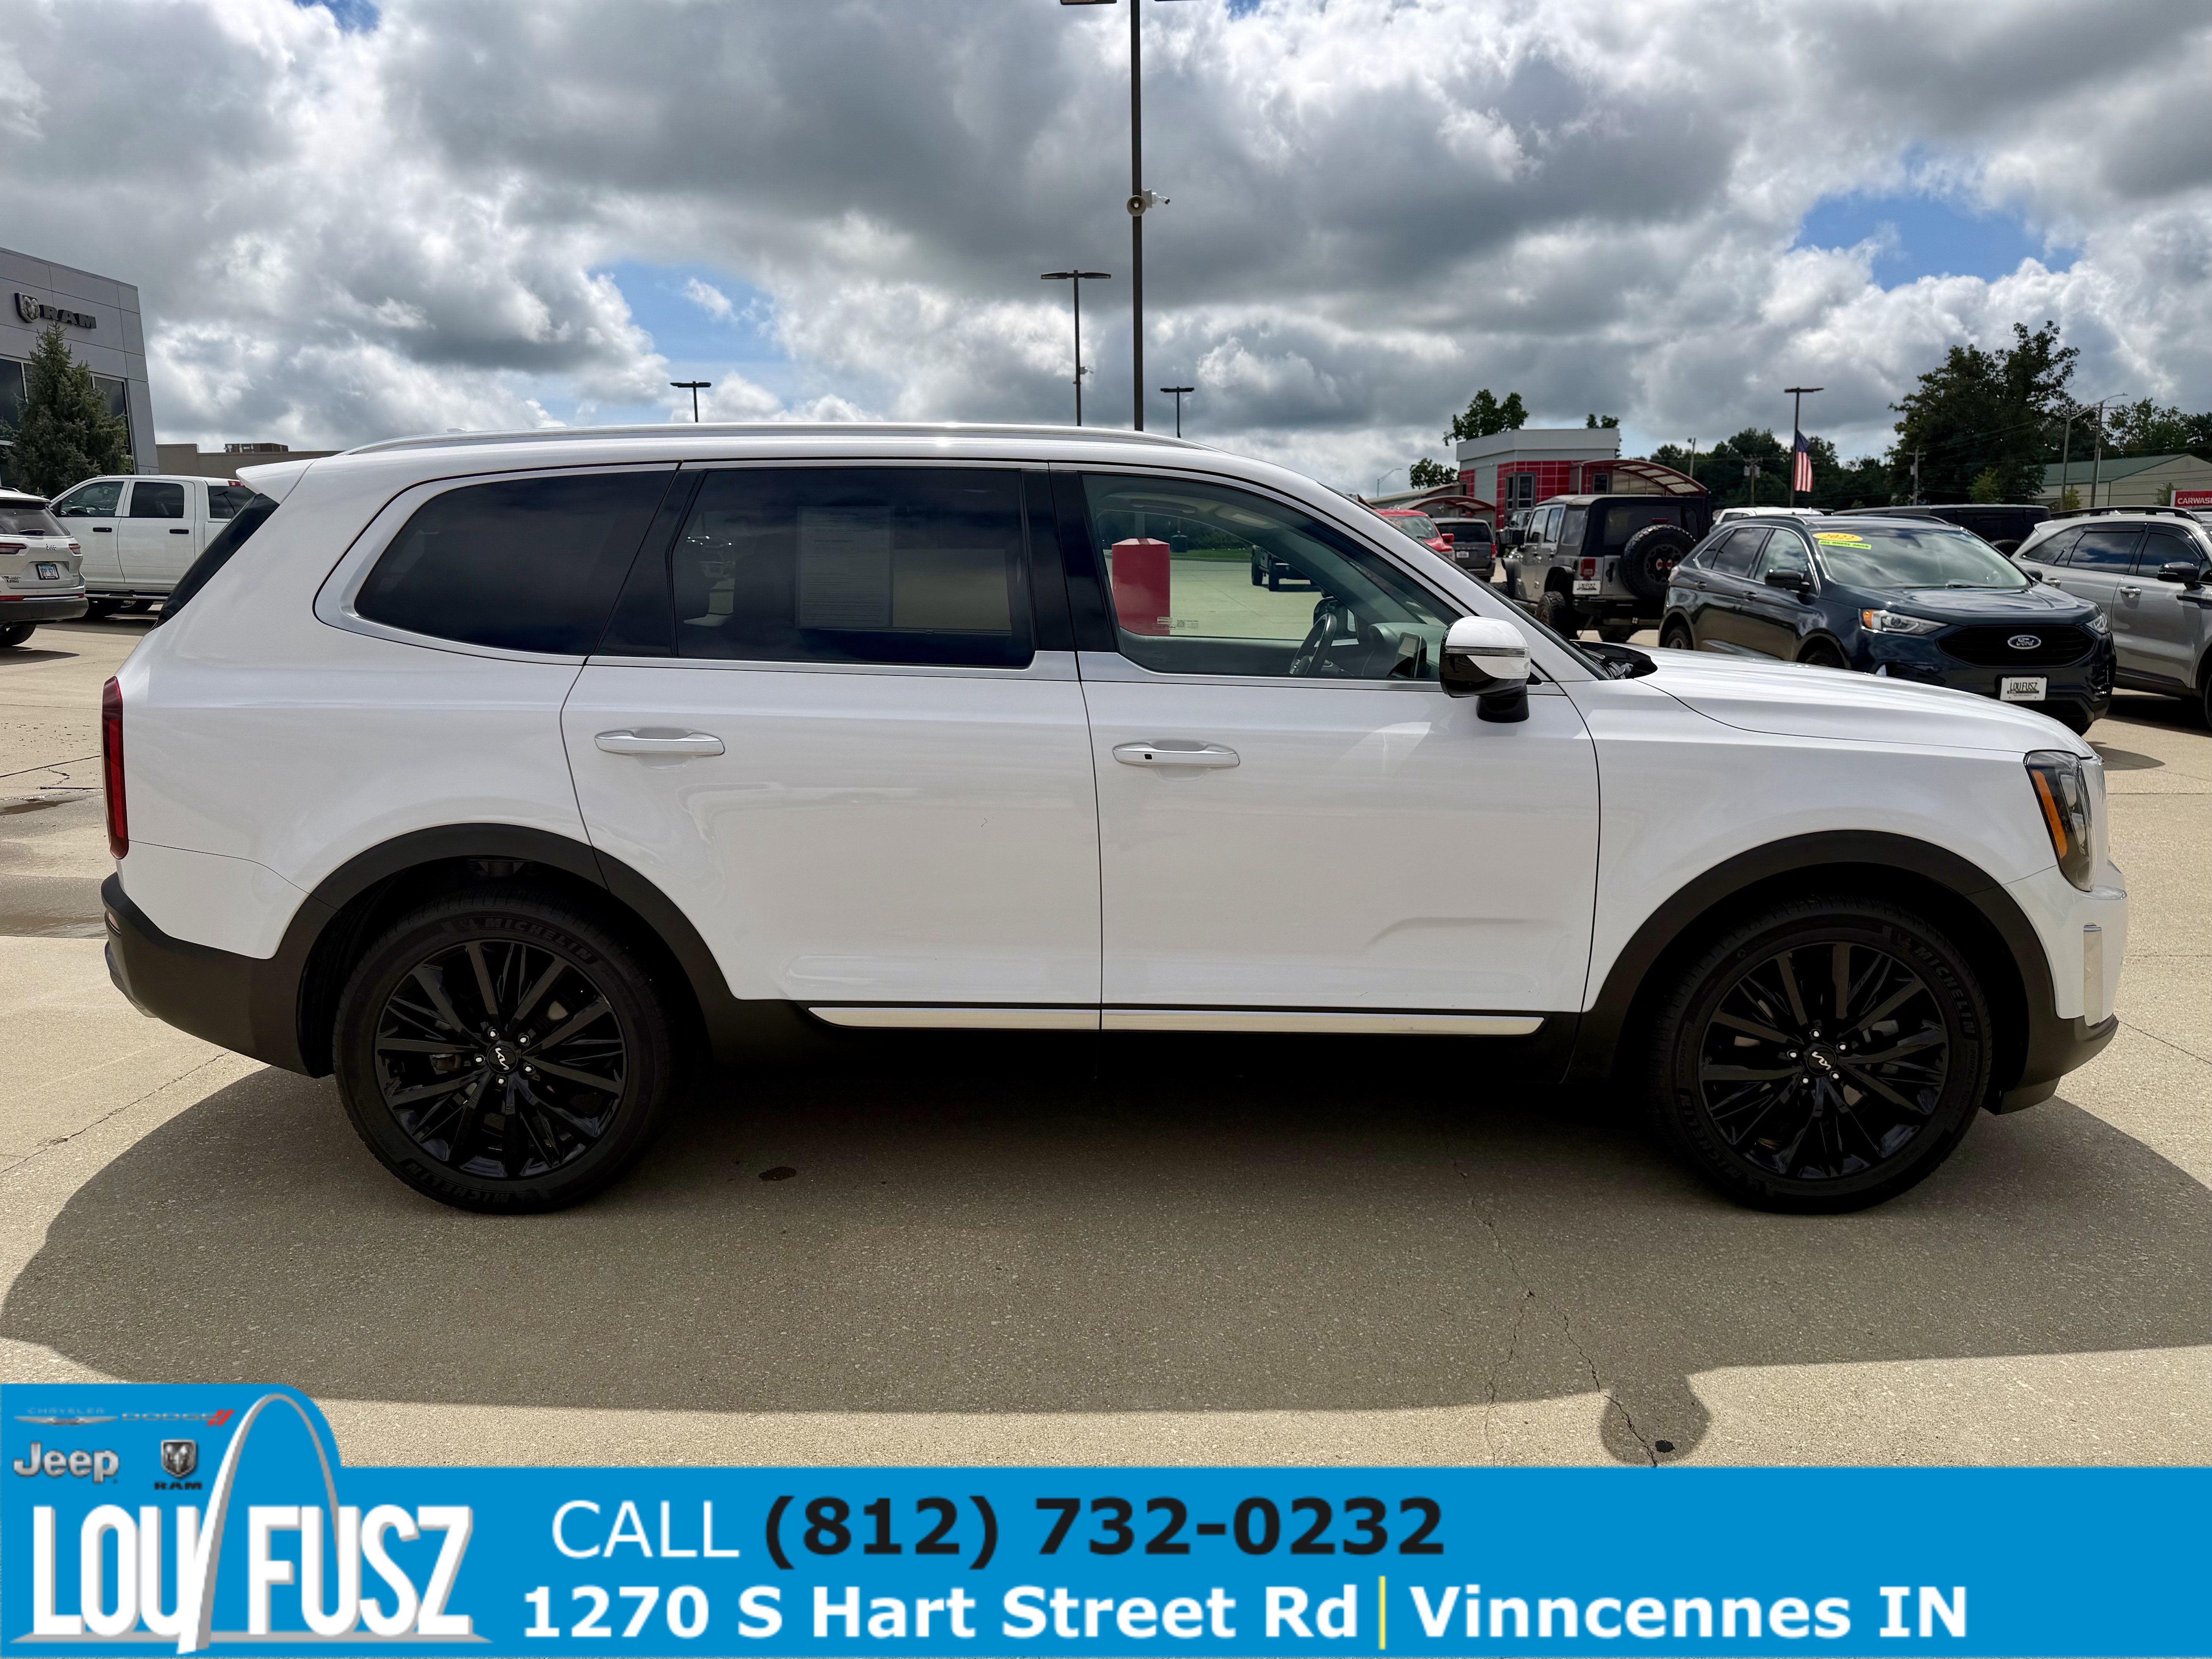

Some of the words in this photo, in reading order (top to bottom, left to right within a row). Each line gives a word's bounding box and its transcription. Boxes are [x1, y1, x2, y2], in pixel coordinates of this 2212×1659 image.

[39, 304, 96, 329] RAM
[2016, 637, 2034, 646] Ford
[484, 917, 594, 960] MICHELIN
[1914, 946, 1975, 1034] MICHELIN
[405, 1163, 510, 1203] MICHELIN
